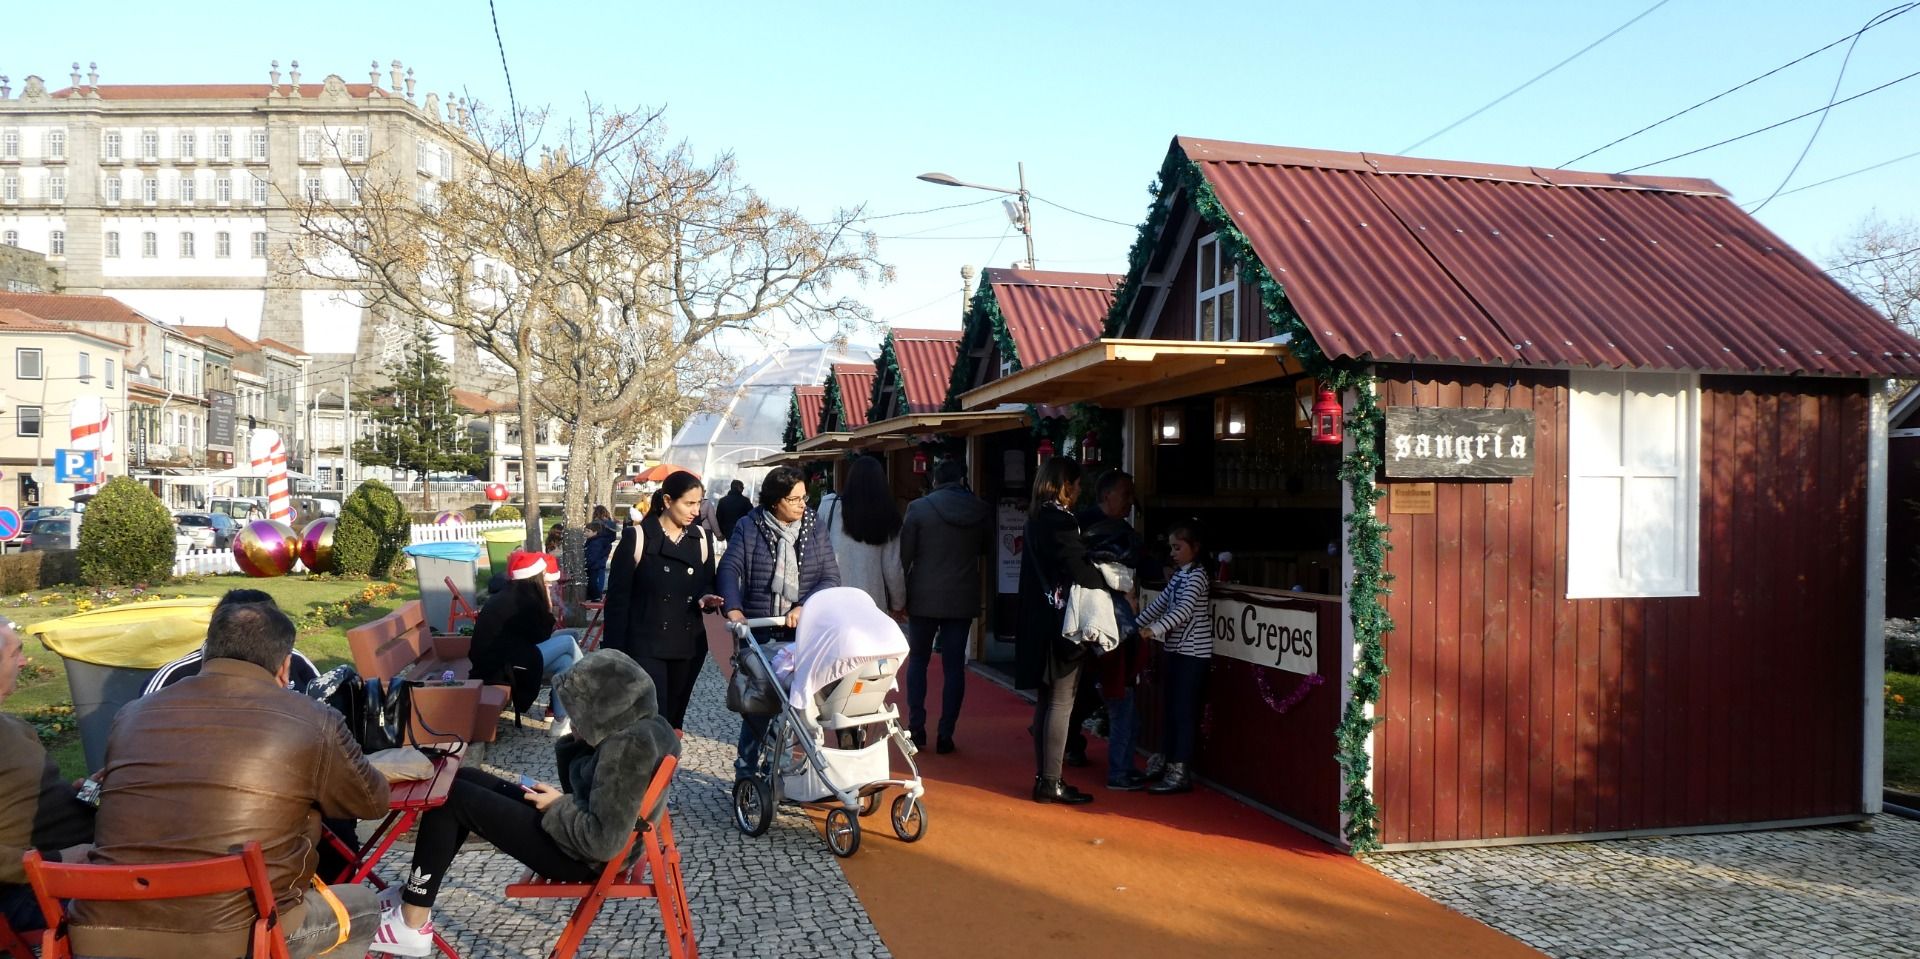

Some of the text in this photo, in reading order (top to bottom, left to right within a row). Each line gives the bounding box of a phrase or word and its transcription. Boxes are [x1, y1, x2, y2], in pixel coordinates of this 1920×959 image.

[65, 455, 85, 475] P
[1241, 604, 1313, 666] Crepes
[406, 884, 427, 894] didas
